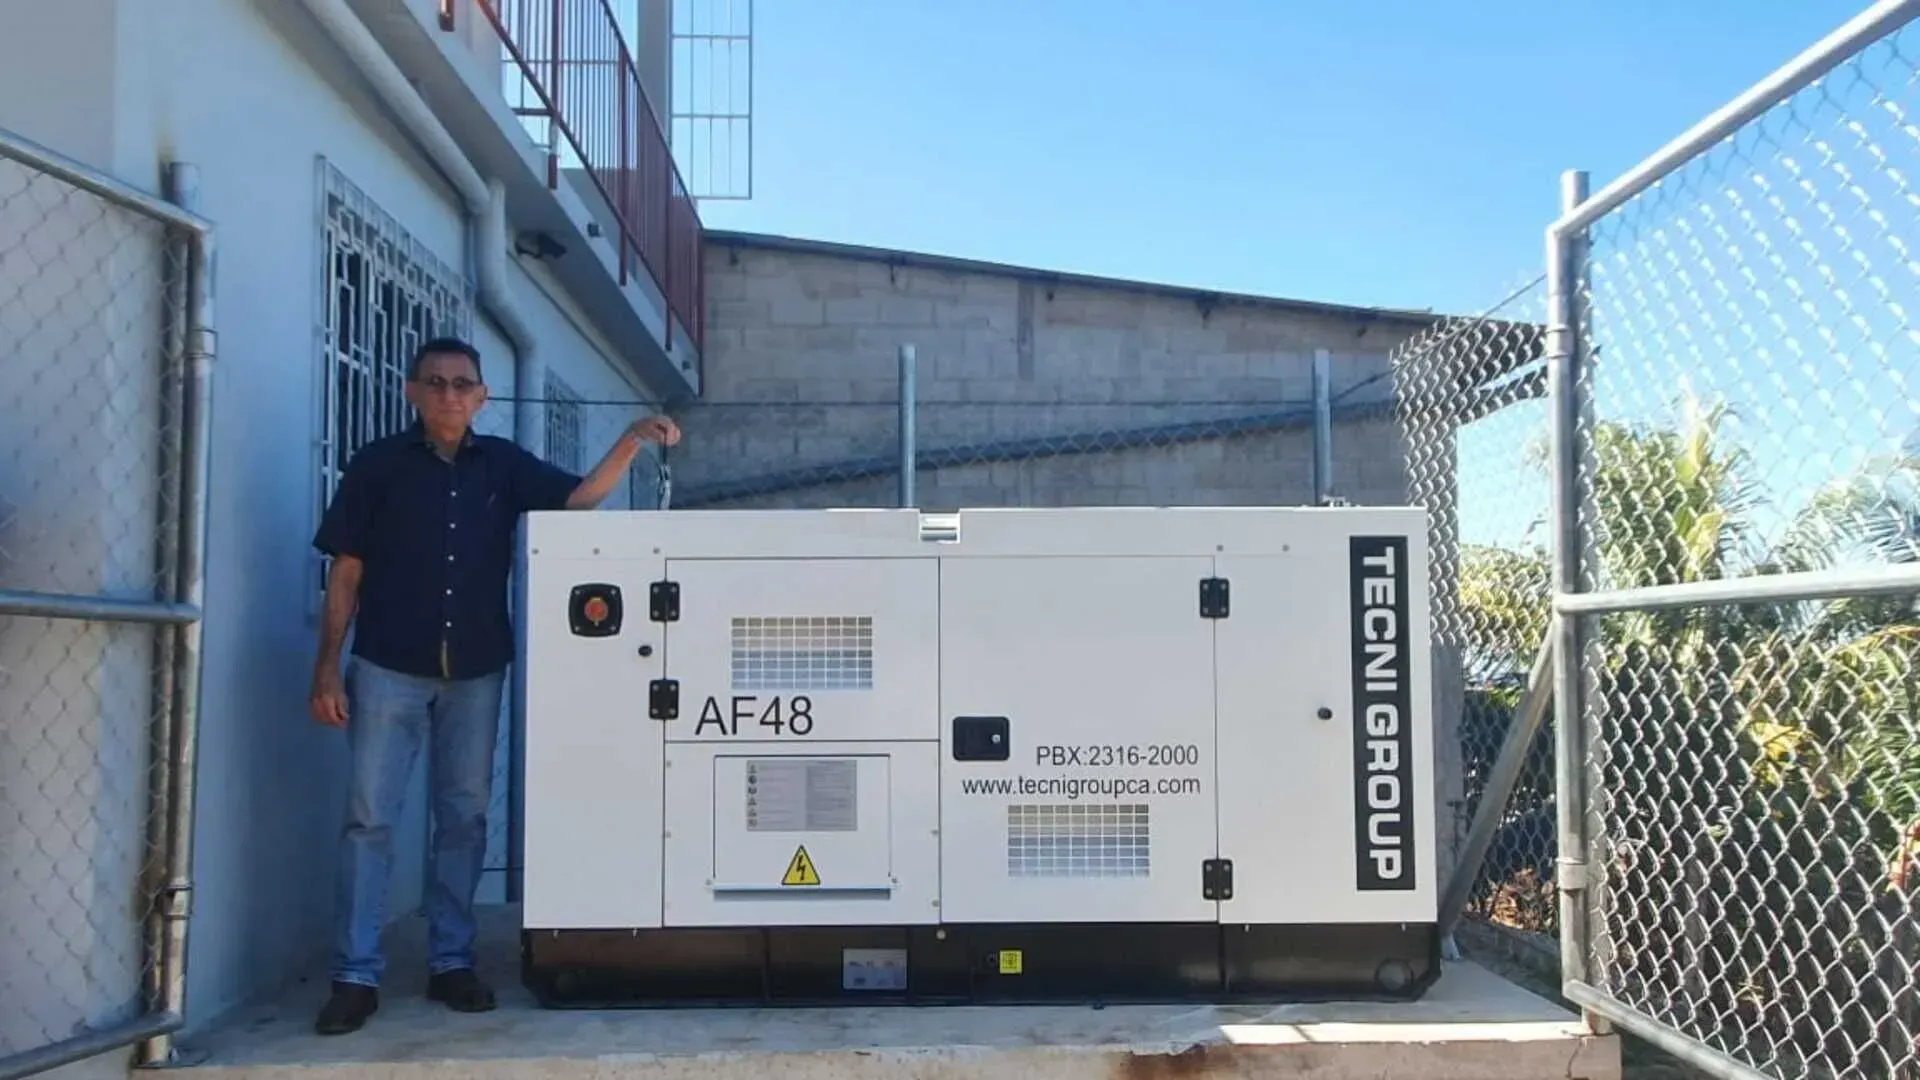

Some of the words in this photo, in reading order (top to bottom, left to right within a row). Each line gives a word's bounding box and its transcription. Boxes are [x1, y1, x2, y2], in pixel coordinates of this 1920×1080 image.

[1362, 546, 1398, 692] TECNI
[694, 695, 813, 736] AF48
[1036, 745, 1199, 766] PBX:2316-2000
[962, 775, 1201, 799] www.tecnigroupca.com
[1366, 703, 1402, 880] GROUP
